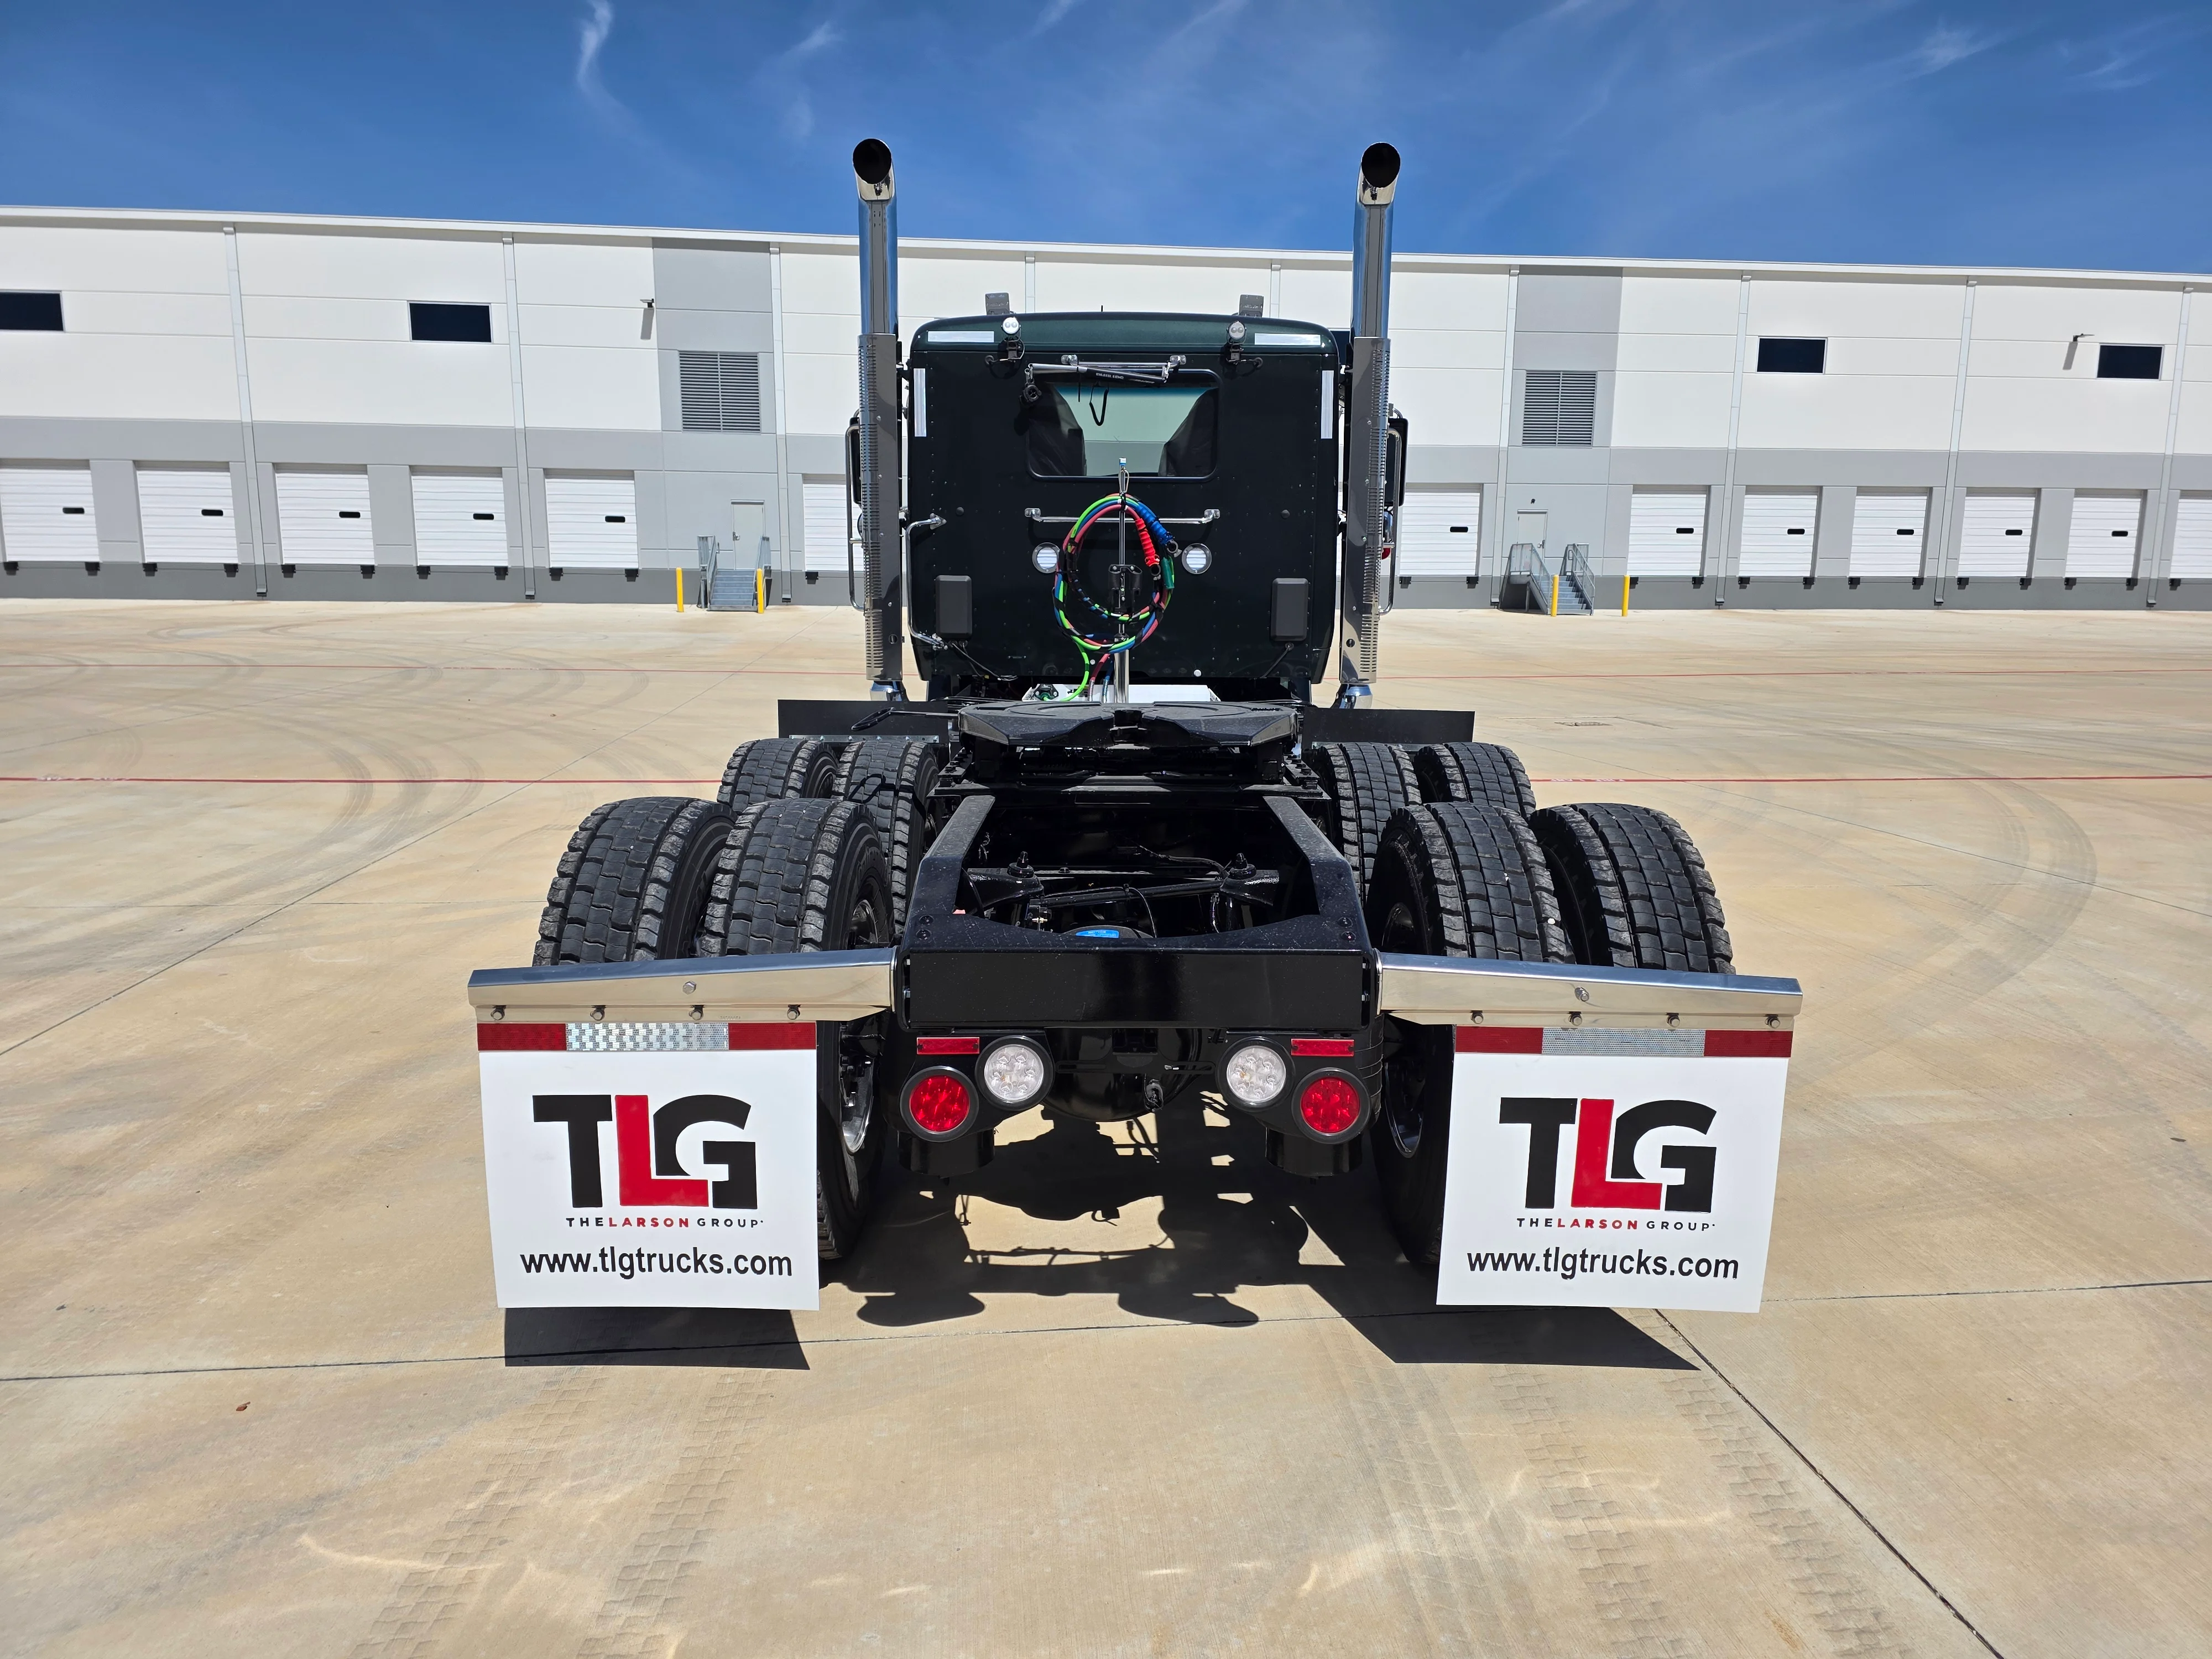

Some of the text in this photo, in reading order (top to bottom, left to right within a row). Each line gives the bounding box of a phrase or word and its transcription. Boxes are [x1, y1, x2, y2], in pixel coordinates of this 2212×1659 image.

[533, 1094, 758, 1210] TLG
[1499, 1097, 1717, 1213] TLG
[697, 1218, 758, 1228] GROUP
[1646, 1220, 1709, 1232] GROUP
[519, 1246, 792, 1280] www.tlgtrucks.com
[1467, 1246, 1739, 1281] www.tlgtrucks.com
